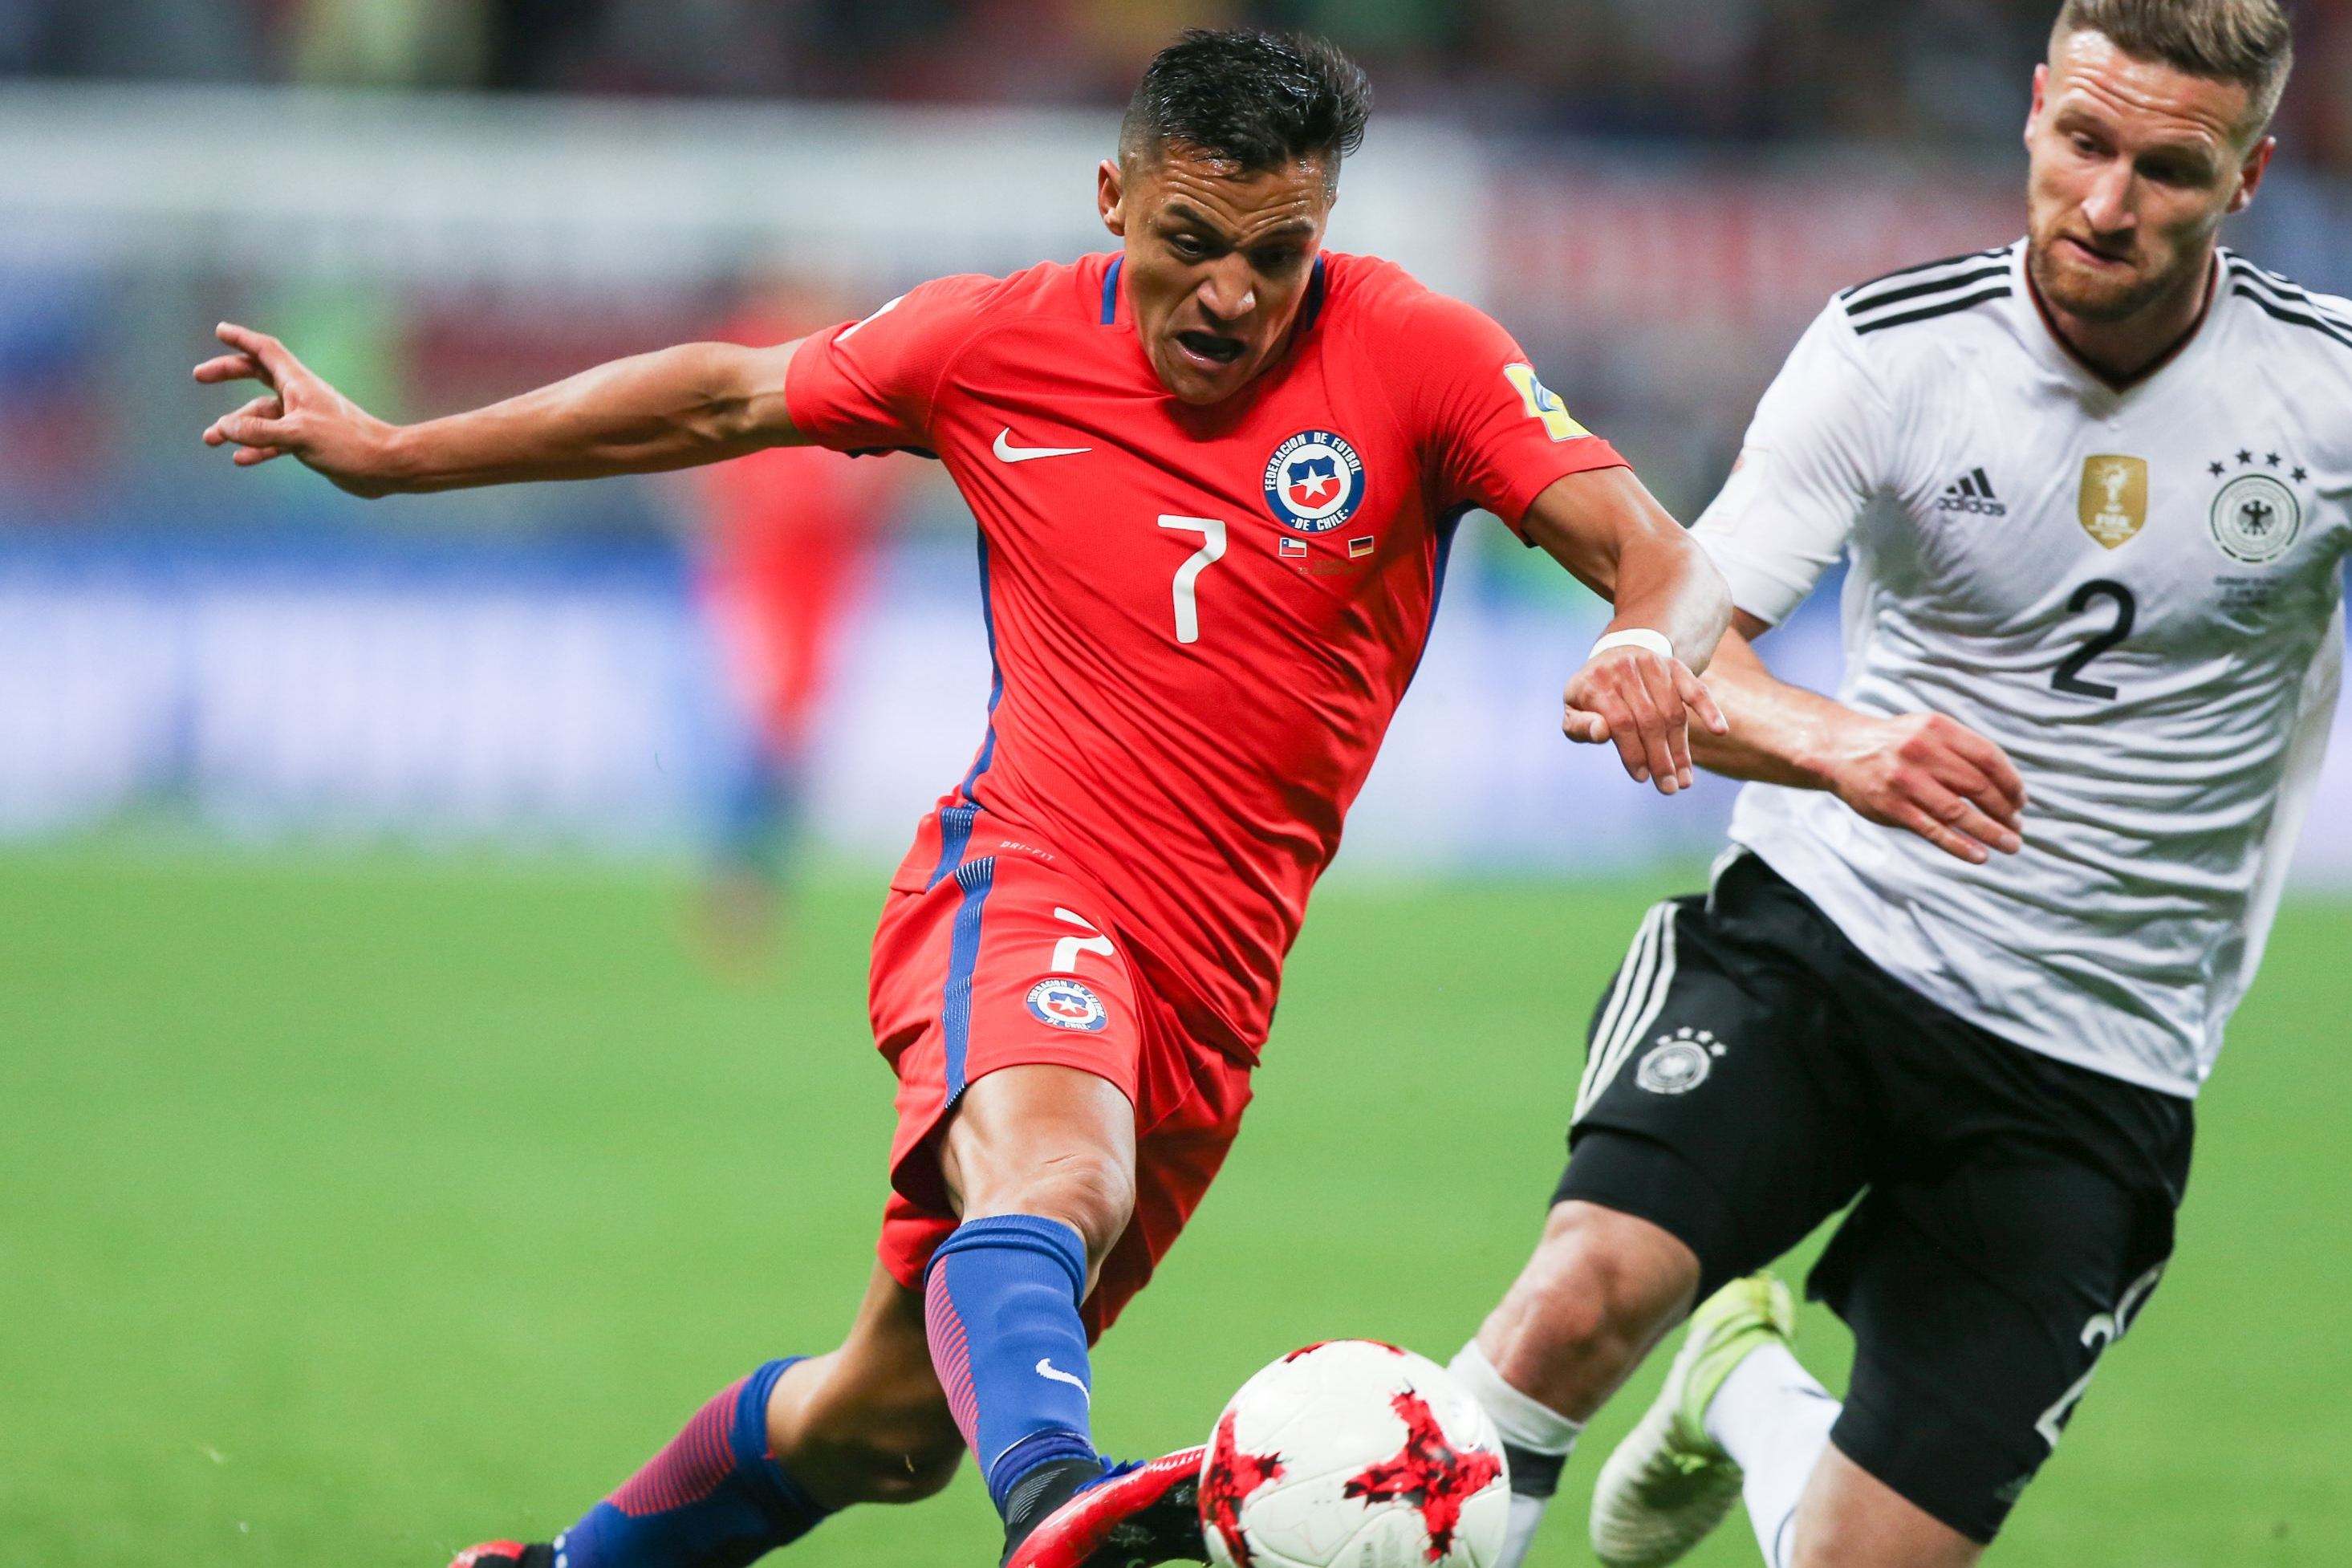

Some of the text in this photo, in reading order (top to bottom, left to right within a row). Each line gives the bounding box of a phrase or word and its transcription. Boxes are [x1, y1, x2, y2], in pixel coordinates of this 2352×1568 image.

[1265, 432, 1363, 491] FEDERACION DE FUTBOL
[1294, 510, 1347, 530] DE CHILE
[1936, 497, 2005, 517] adidas
[1157, 514, 1227, 643] 7
[2050, 579, 2135, 701] 2
[1000, 841, 1054, 861] DRI-FIT
[1051, 907, 1114, 973] 7
